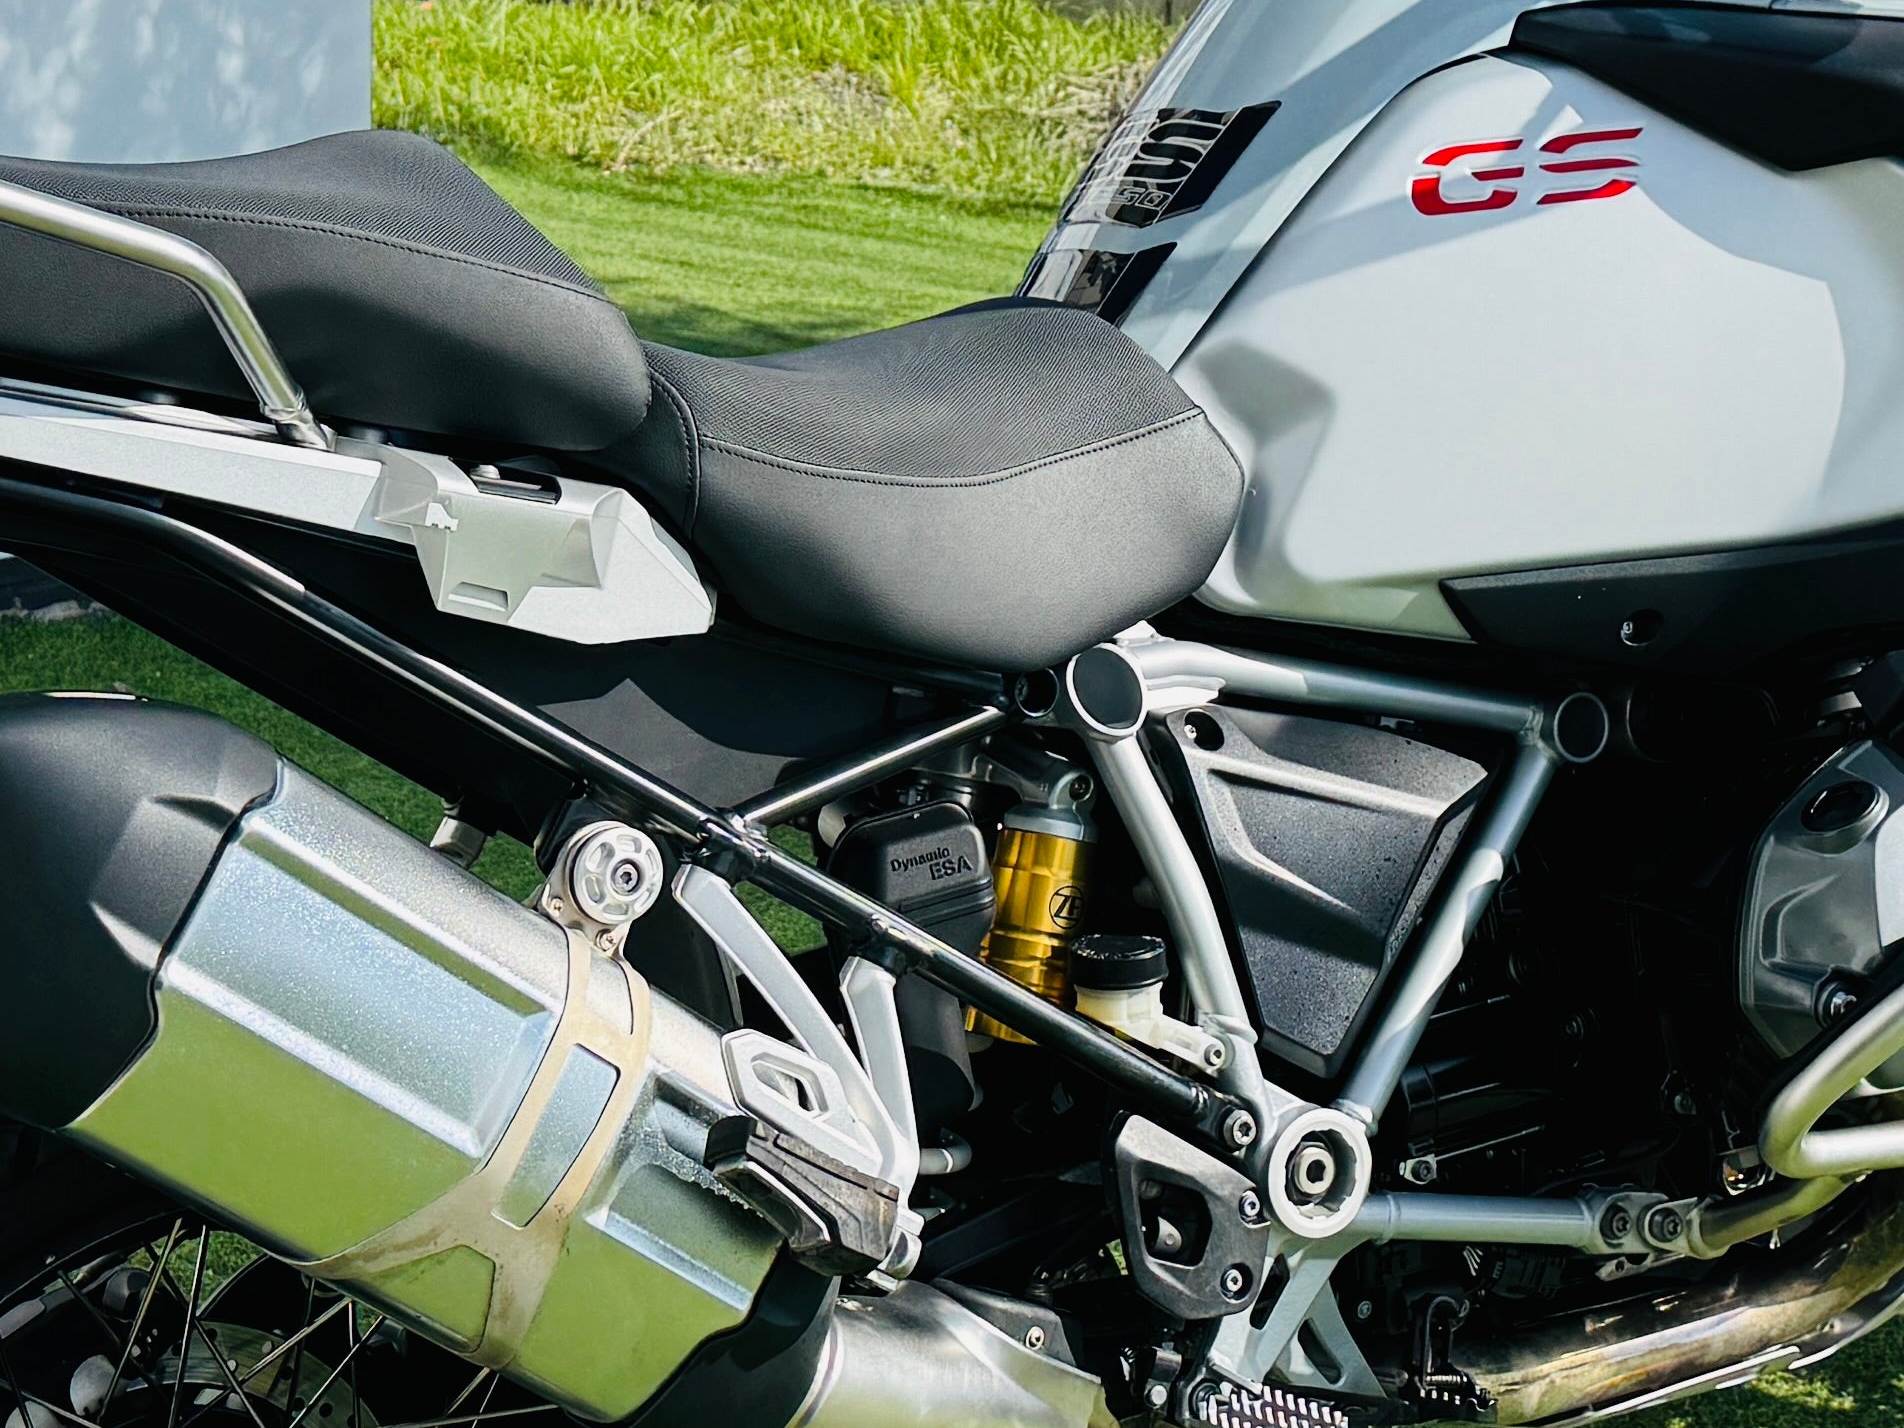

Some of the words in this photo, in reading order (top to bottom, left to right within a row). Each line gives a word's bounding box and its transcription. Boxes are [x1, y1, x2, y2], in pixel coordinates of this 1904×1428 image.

[1408, 126, 1644, 216] GS
[889, 845, 951, 873] Dynamic
[929, 855, 974, 881] ESA
[1052, 892, 1084, 920] ZF
